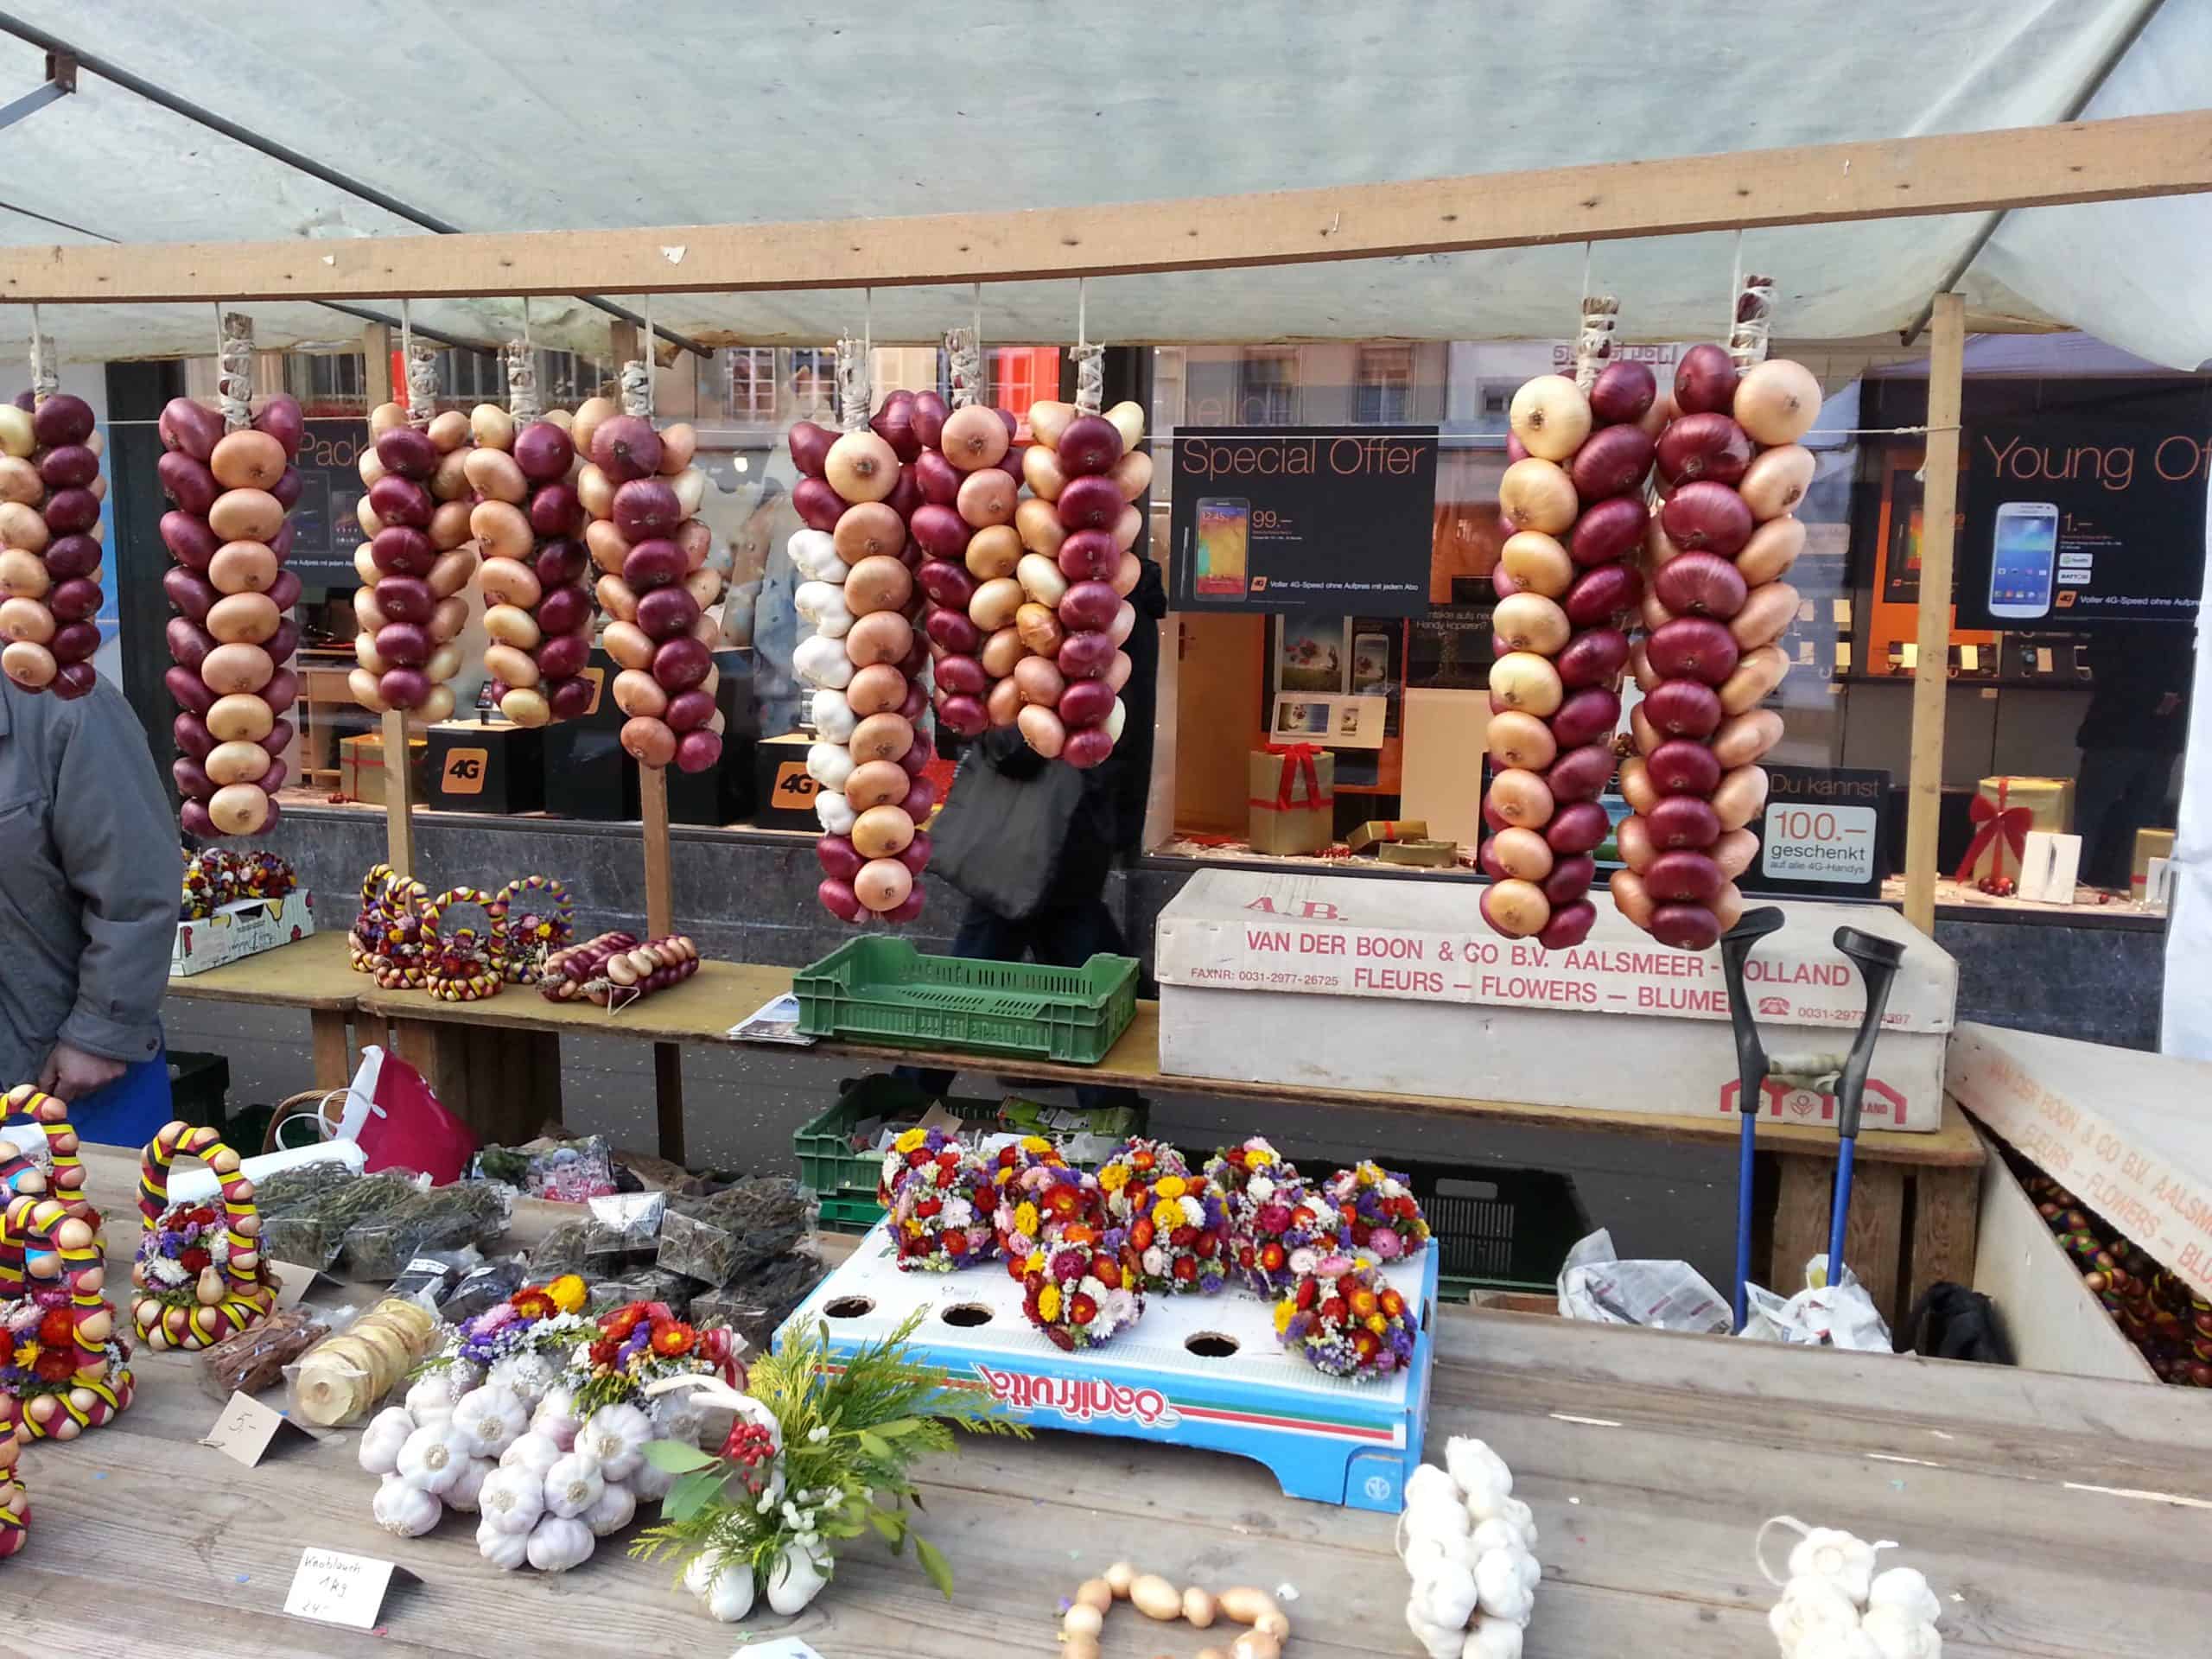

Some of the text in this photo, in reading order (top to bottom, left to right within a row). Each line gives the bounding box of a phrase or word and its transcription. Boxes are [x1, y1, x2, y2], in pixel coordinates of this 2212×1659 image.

[1182, 437, 1426, 481] Special Offer
[1984, 435, 2134, 491] Young
[1325, 581, 1343, 589] ohne
[1371, 582, 1382, 590] mit
[2105, 595, 2148, 606] 4G-Speed
[2150, 596, 2172, 606] ohne
[449, 760, 480, 779] 4G
[781, 773, 814, 794] 4G
[1770, 773, 1879, 798] Du kannst
[1771, 844, 1866, 861] geschenkt
[1770, 861, 1786, 869] auf
[1808, 861, 1866, 875] 4G-Handys
[1247, 930, 1291, 953] VAN
[1300, 932, 1346, 956] DER
[1357, 936, 1424, 960] BOON
[1439, 940, 1454, 962] &
[1465, 942, 1499, 964] CO
[1511, 945, 1549, 968] B.V.
[1564, 948, 1705, 978] AALSMEER
[1743, 959, 1851, 987] OLLAND
[1191, 967, 1339, 987] FAXNR: 0031-2977-26725
[1355, 967, 1444, 993] FLEURS
[1482, 975, 1599, 1005] FLOWERS
[2041, 1092, 2081, 1135] BOON
[2095, 1133, 2122, 1164] CO
[2024, 1123, 2074, 1172] FLEURS
[2085, 1171, 2162, 1239] FLOWERS
